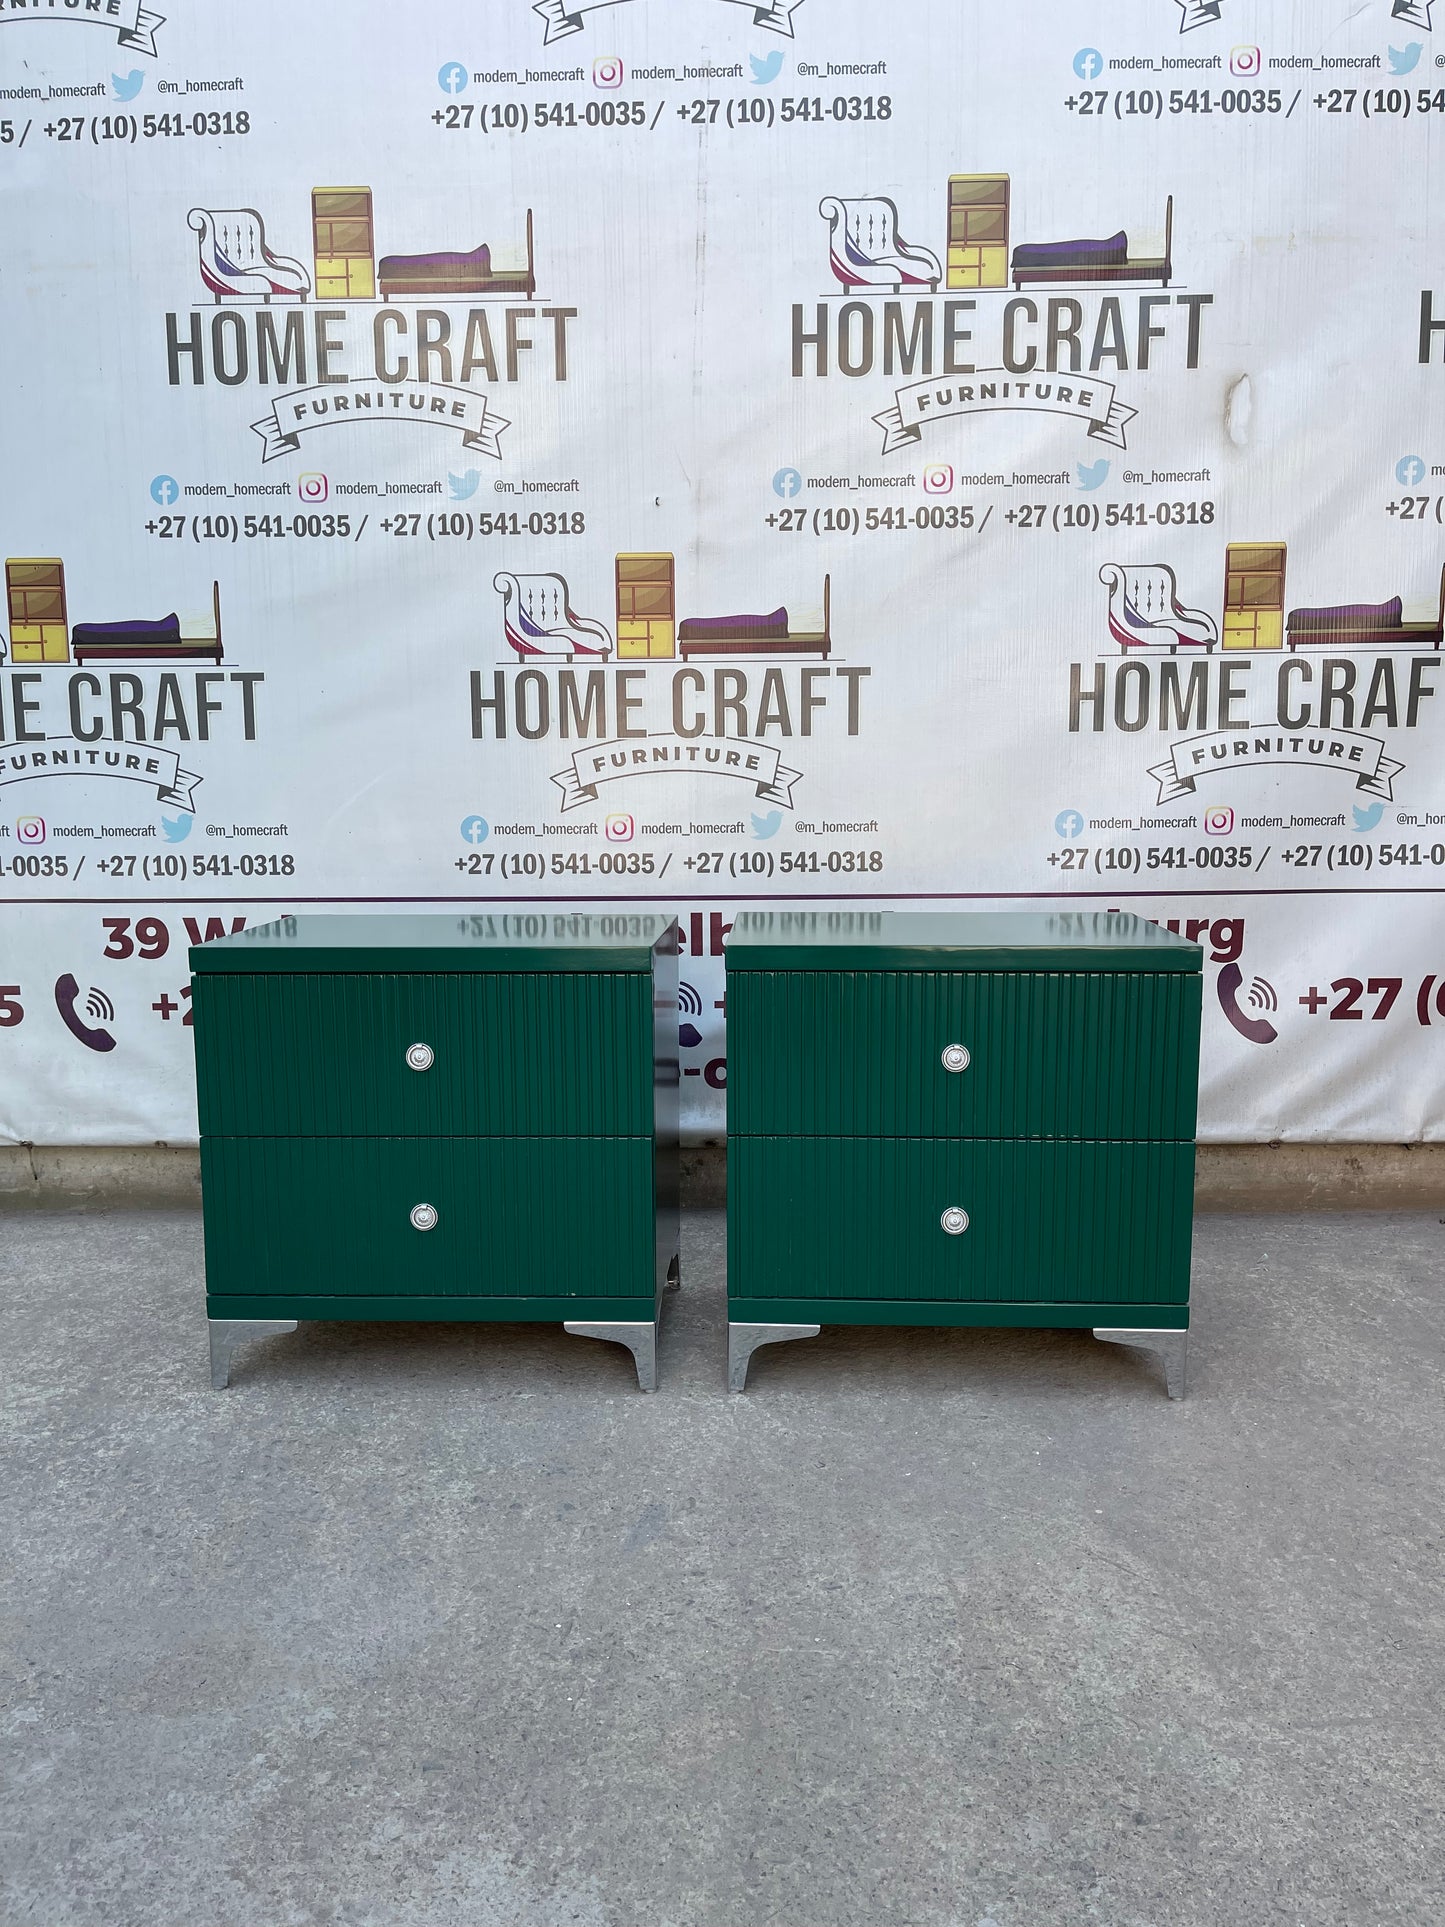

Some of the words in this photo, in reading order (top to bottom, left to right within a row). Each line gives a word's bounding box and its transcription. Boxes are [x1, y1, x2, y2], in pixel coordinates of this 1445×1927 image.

[798, 61, 886, 78] @m_homecraft
[158, 77, 243, 95] @m_homecraft
[432, 105, 474, 128] +27
[481, 104, 528, 133] (10)
[535, 101, 645, 127] 541-0035
[677, 100, 720, 123] +27
[727, 99, 774, 128] (10)
[781, 96, 891, 122] 541-0318
[1065, 91, 1108, 114] +27
[1115, 90, 1162, 119] (10)
[1169, 90, 1281, 113] 541-0035
[1313, 89, 1357, 112] +27
[1363, 89, 1410, 118] (10)
[44, 118, 84, 140] +27
[92, 116, 137, 144] (10)
[143, 111, 250, 137] 541-0318
[165, 310, 350, 386] HOME
[373, 307, 578, 383] CRAFT
[791, 299, 977, 378] HOME
[1002, 294, 1214, 374] CRAFT
[293, 392, 467, 421] FURNITURE
[917, 381, 1094, 412] FURNITURE
[494, 479, 579, 494] @m_homecraft
[1123, 469, 1210, 485] @m_homecraft
[765, 509, 807, 531] +27
[813, 508, 859, 536] (10)
[866, 506, 974, 530] 541-0035
[1005, 505, 1046, 527] +27
[1053, 504, 1099, 532] (10)
[1105, 502, 1214, 526] 541-0318
[1386, 497, 1429, 519] +27
[145, 516, 185, 538] +27
[193, 516, 238, 543] (10)
[244, 515, 350, 537] 541-0035
[380, 514, 421, 536] +27
[428, 513, 473, 540] (10)
[479, 512, 585, 535] 541-0318
[0, 674, 45, 741] E
[68, 671, 265, 742] CRAFT
[470, 670, 648, 740] HOME
[672, 667, 872, 738] CRAFT
[1068, 660, 1252, 733] HOME
[1277, 657, 1441, 729] CRAF
[592, 746, 761, 773] FURNITURE
[1191, 737, 1364, 766] FURNITURE
[206, 824, 288, 838] @m_homecraft
[795, 820, 878, 834] @m_homecraft
[97, 856, 136, 876] +27
[143, 855, 187, 881] (10)
[193, 855, 295, 876] 541-0318
[455, 854, 494, 874] +27
[501, 854, 545, 879] (10)
[551, 853, 654, 874] 541-0035
[684, 853, 723, 873] +27
[730, 852, 774, 878] (10)
[780, 851, 882, 873] 541-0318
[1047, 849, 1088, 869] +27
[1095, 848, 1140, 874] (10)
[1147, 847, 1252, 869] 541-0035
[1282, 846, 1322, 866] +27
[1327, 845, 1372, 871] (10)
[103, 917, 169, 959] 39
[1299, 978, 1402, 1020] +27
